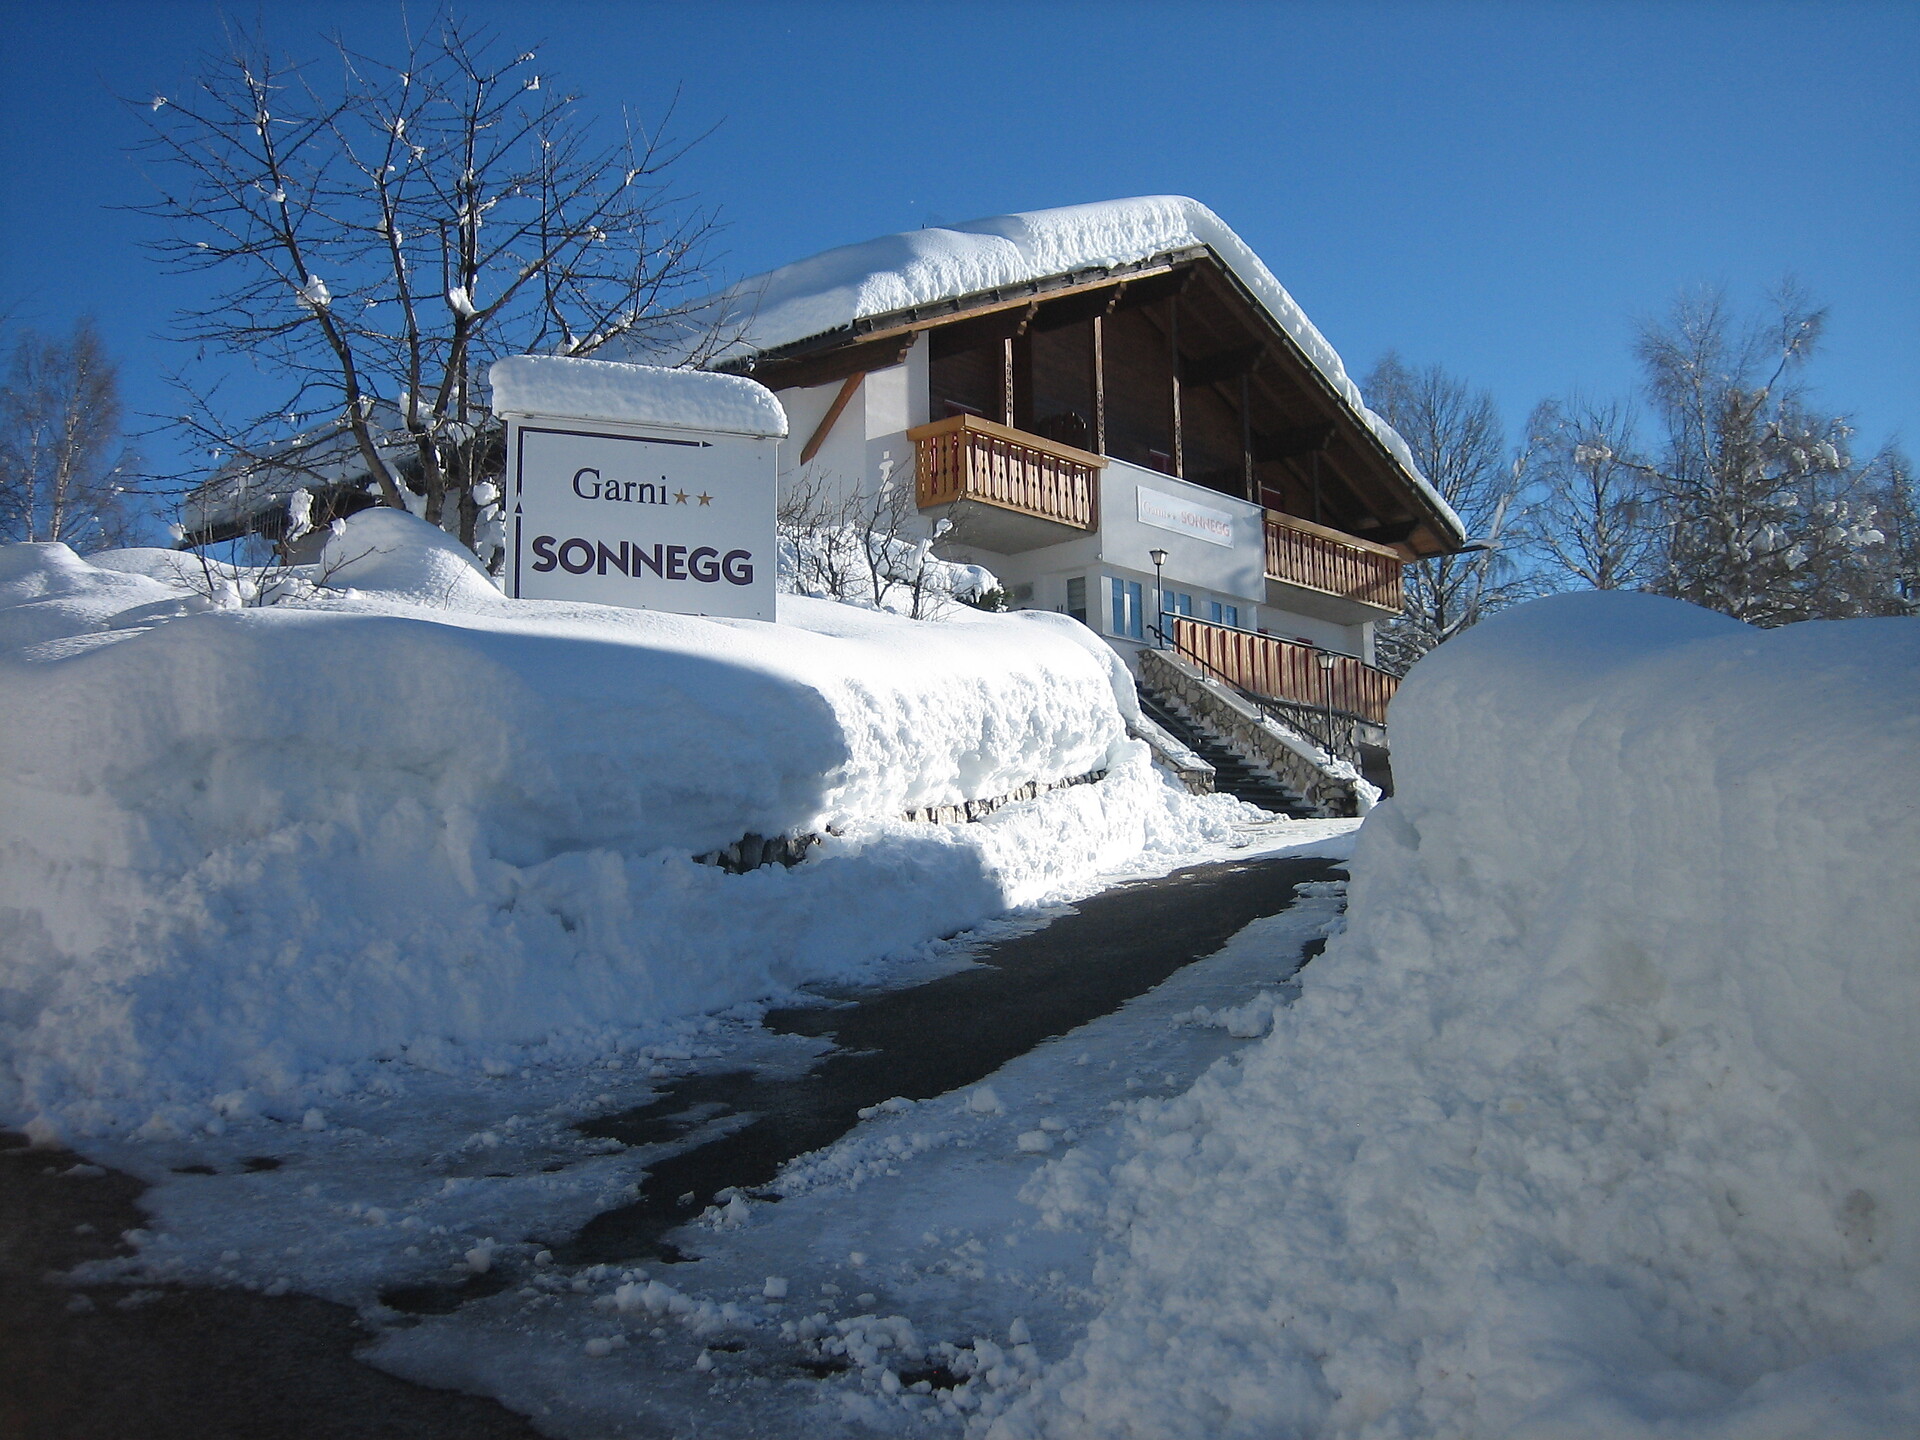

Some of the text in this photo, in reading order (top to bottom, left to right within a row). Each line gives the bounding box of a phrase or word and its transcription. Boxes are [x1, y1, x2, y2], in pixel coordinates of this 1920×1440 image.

[572, 467, 669, 505] Garni
[1181, 511, 1230, 537] SONNEGG
[531, 535, 754, 586] SONNEGG
